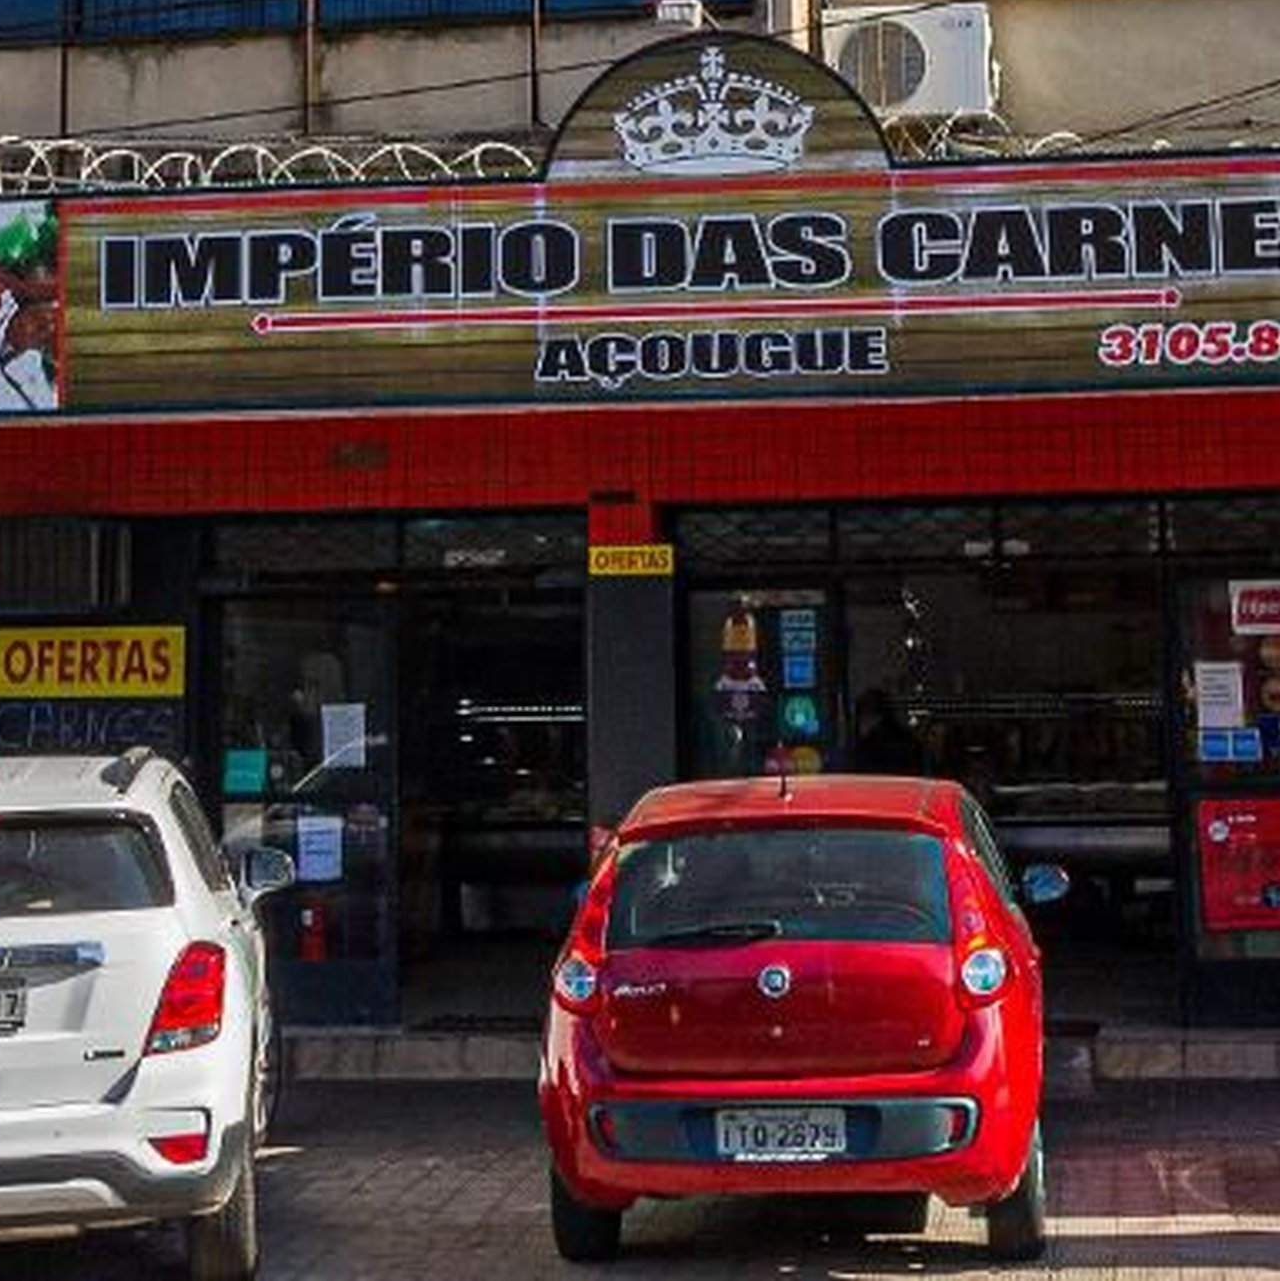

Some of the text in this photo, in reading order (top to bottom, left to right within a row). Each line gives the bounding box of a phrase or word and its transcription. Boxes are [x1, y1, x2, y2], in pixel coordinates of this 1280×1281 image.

[100, 214, 580, 310] IMPÉRIO
[607, 211, 853, 293] DAS
[533, 327, 888, 389] AÇOUGUE
[594, 548, 670, 571] OFERTAS
[3, 638, 173, 685] OFERTAS
